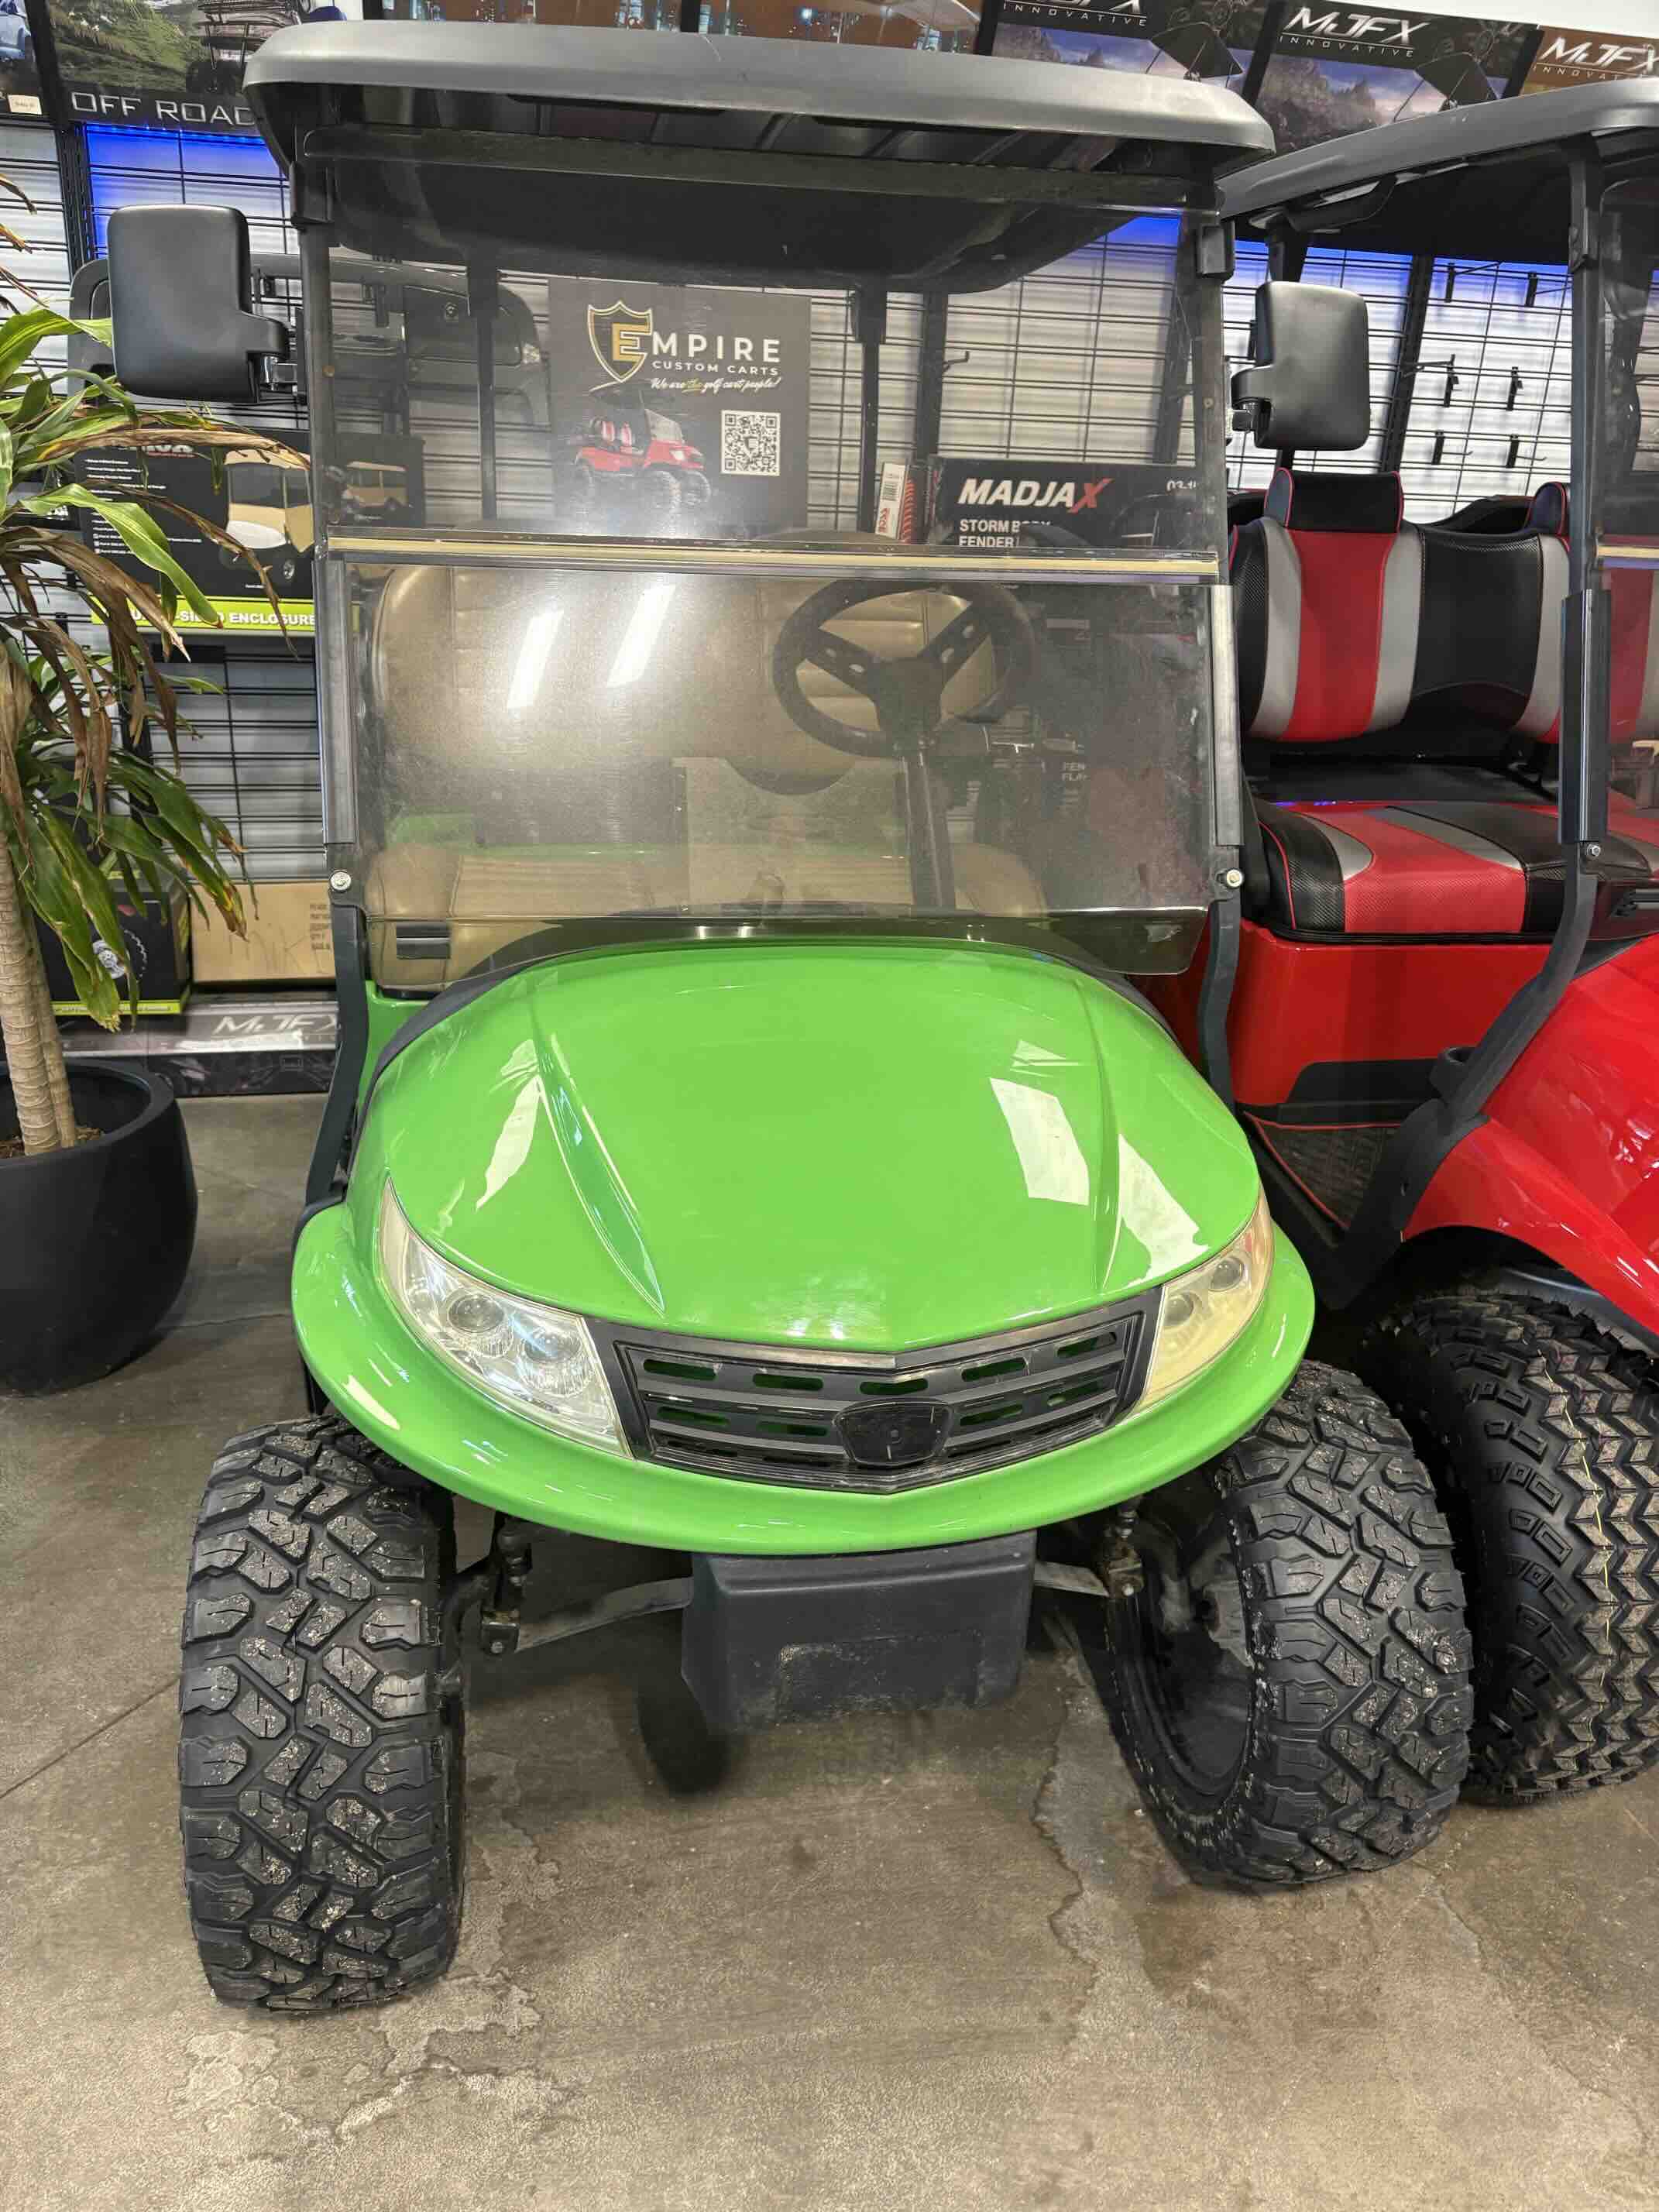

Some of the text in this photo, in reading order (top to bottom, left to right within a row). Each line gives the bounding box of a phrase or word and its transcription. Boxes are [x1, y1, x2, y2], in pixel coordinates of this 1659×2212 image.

[1003, 3, 1147, 26] INNOVATIVE
[1283, 6, 1431, 44] MJFX
[1279, 36, 1414, 57] INNOVATIVE
[71, 91, 142, 116] OFF
[652, 360, 779, 376] CUSTOM CARTS
[957, 477, 1115, 514] MADJAX
[960, 519, 1010, 533] STORM
[960, 535, 1015, 548] FENDER
